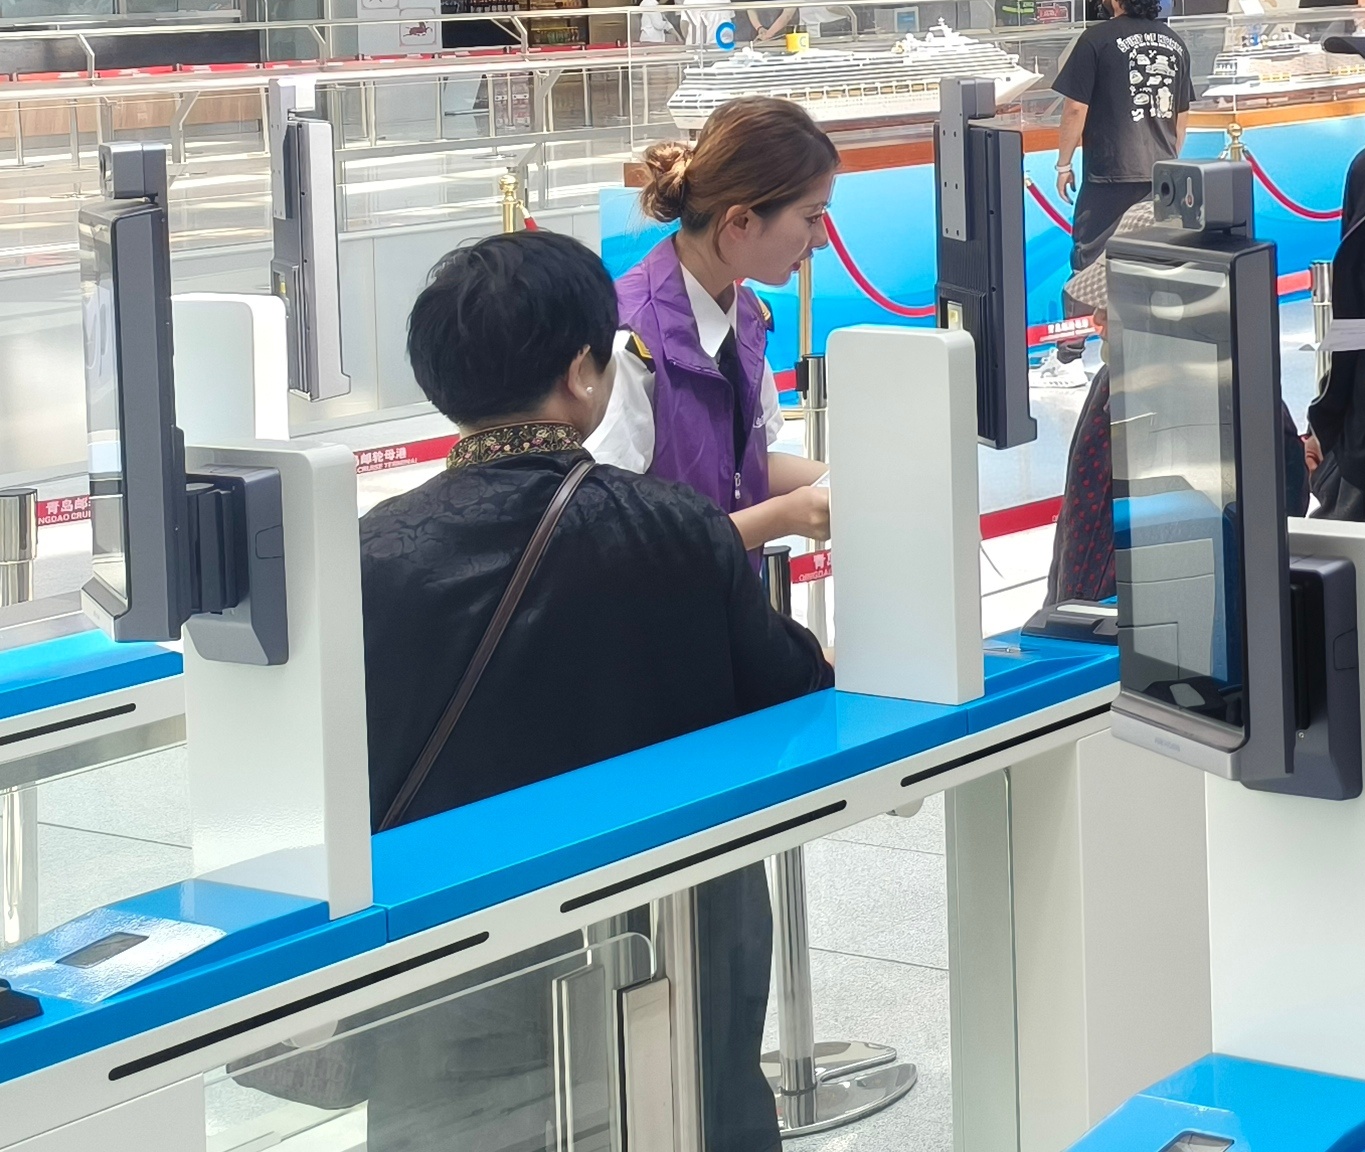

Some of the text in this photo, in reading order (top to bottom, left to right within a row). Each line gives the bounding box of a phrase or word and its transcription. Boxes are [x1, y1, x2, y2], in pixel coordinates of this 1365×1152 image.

[356, 447, 407, 466] 邮轮母港
[46, 497, 91, 515] 青岛邮
